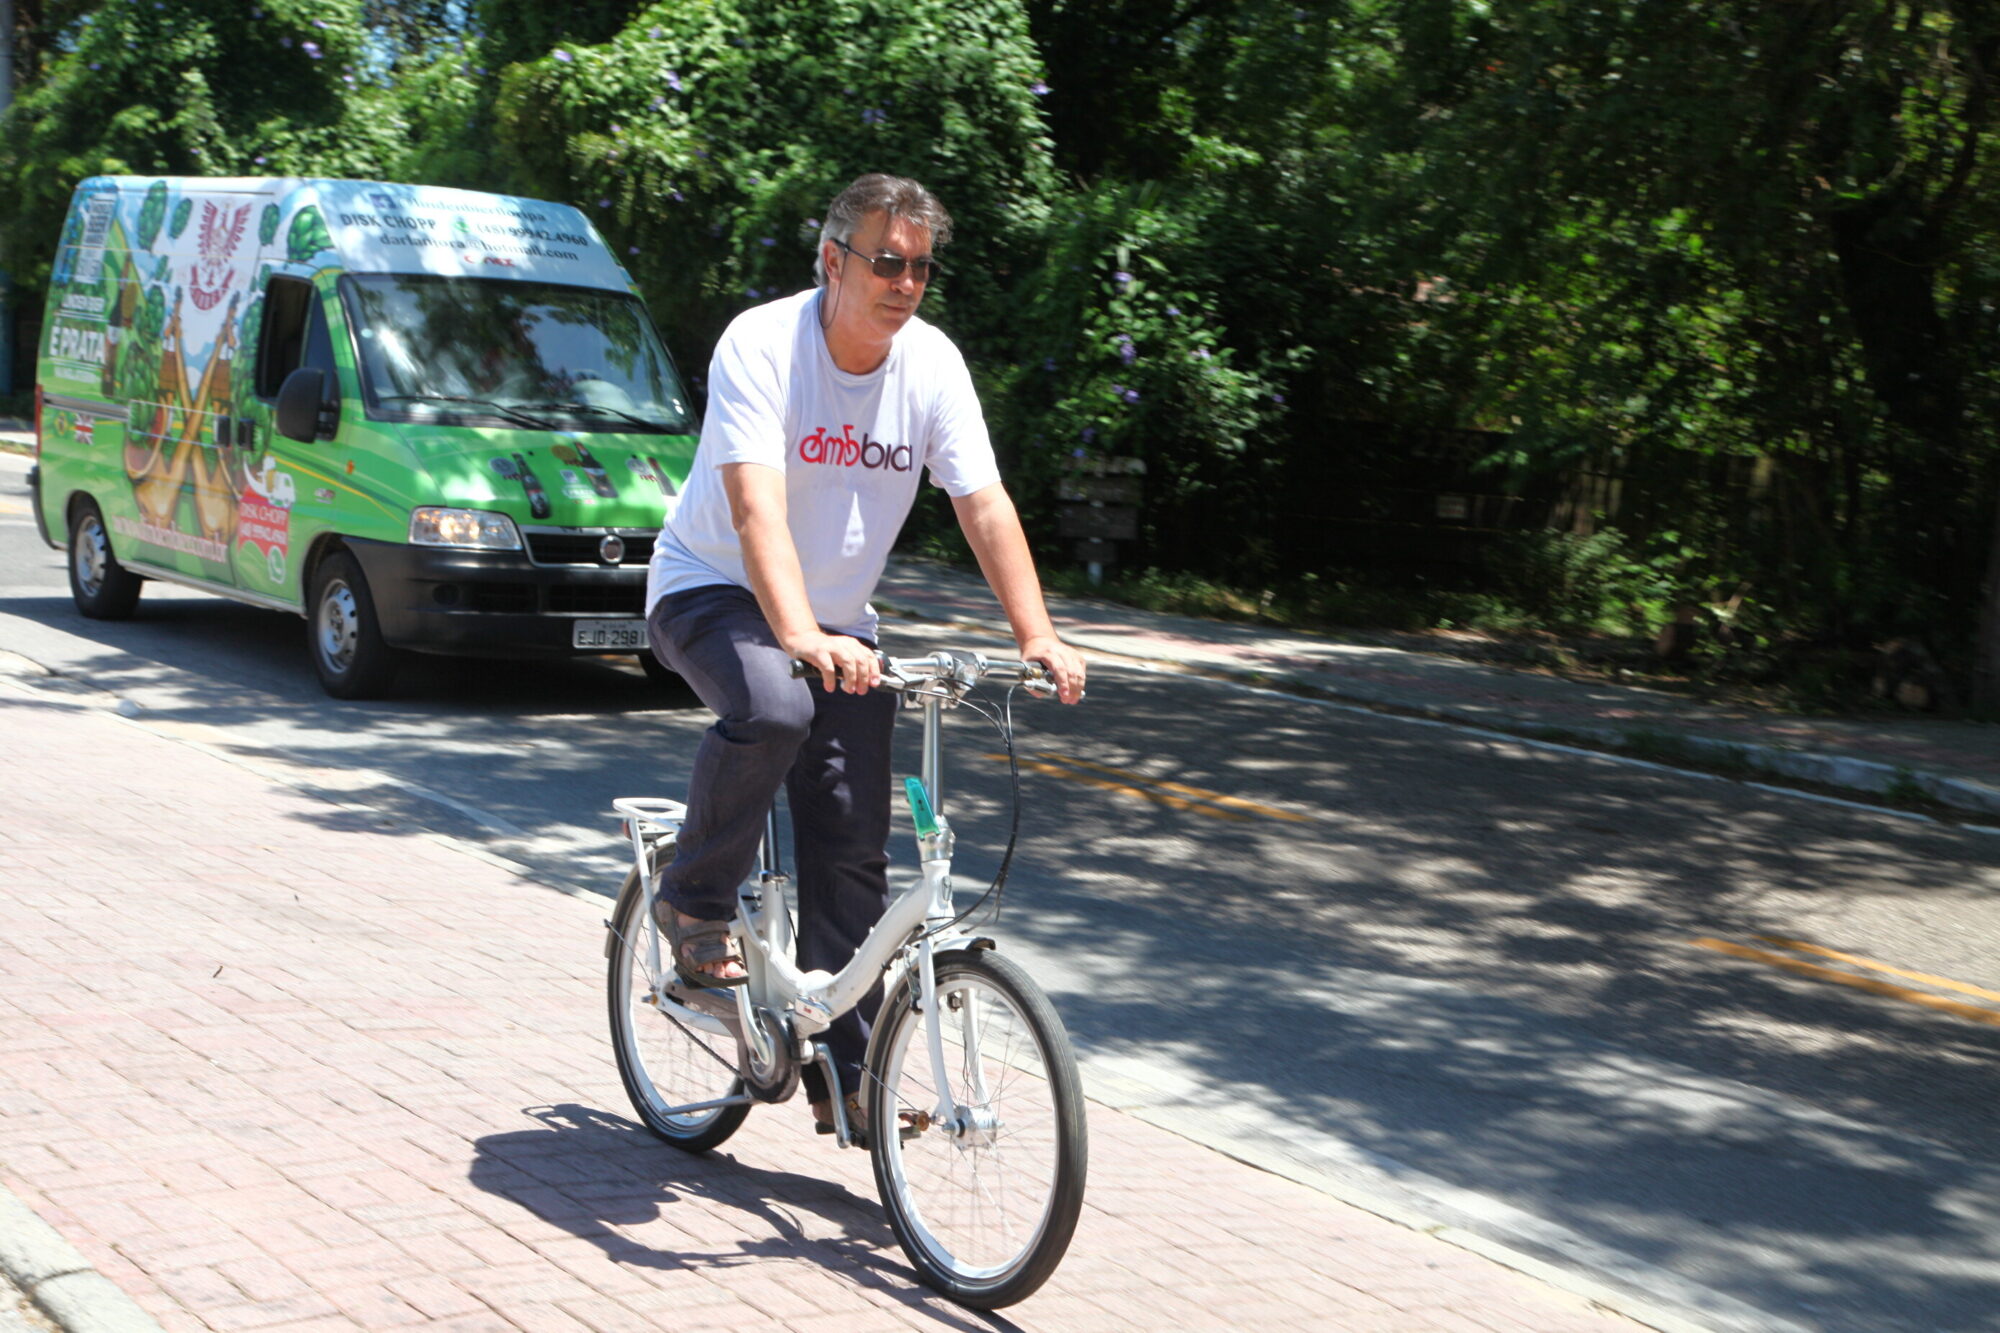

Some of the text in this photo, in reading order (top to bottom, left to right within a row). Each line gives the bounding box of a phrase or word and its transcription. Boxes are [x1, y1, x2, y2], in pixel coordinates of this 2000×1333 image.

[340, 212, 436, 231] DISK CHOPP
[61, 326, 106, 366] PRATA
